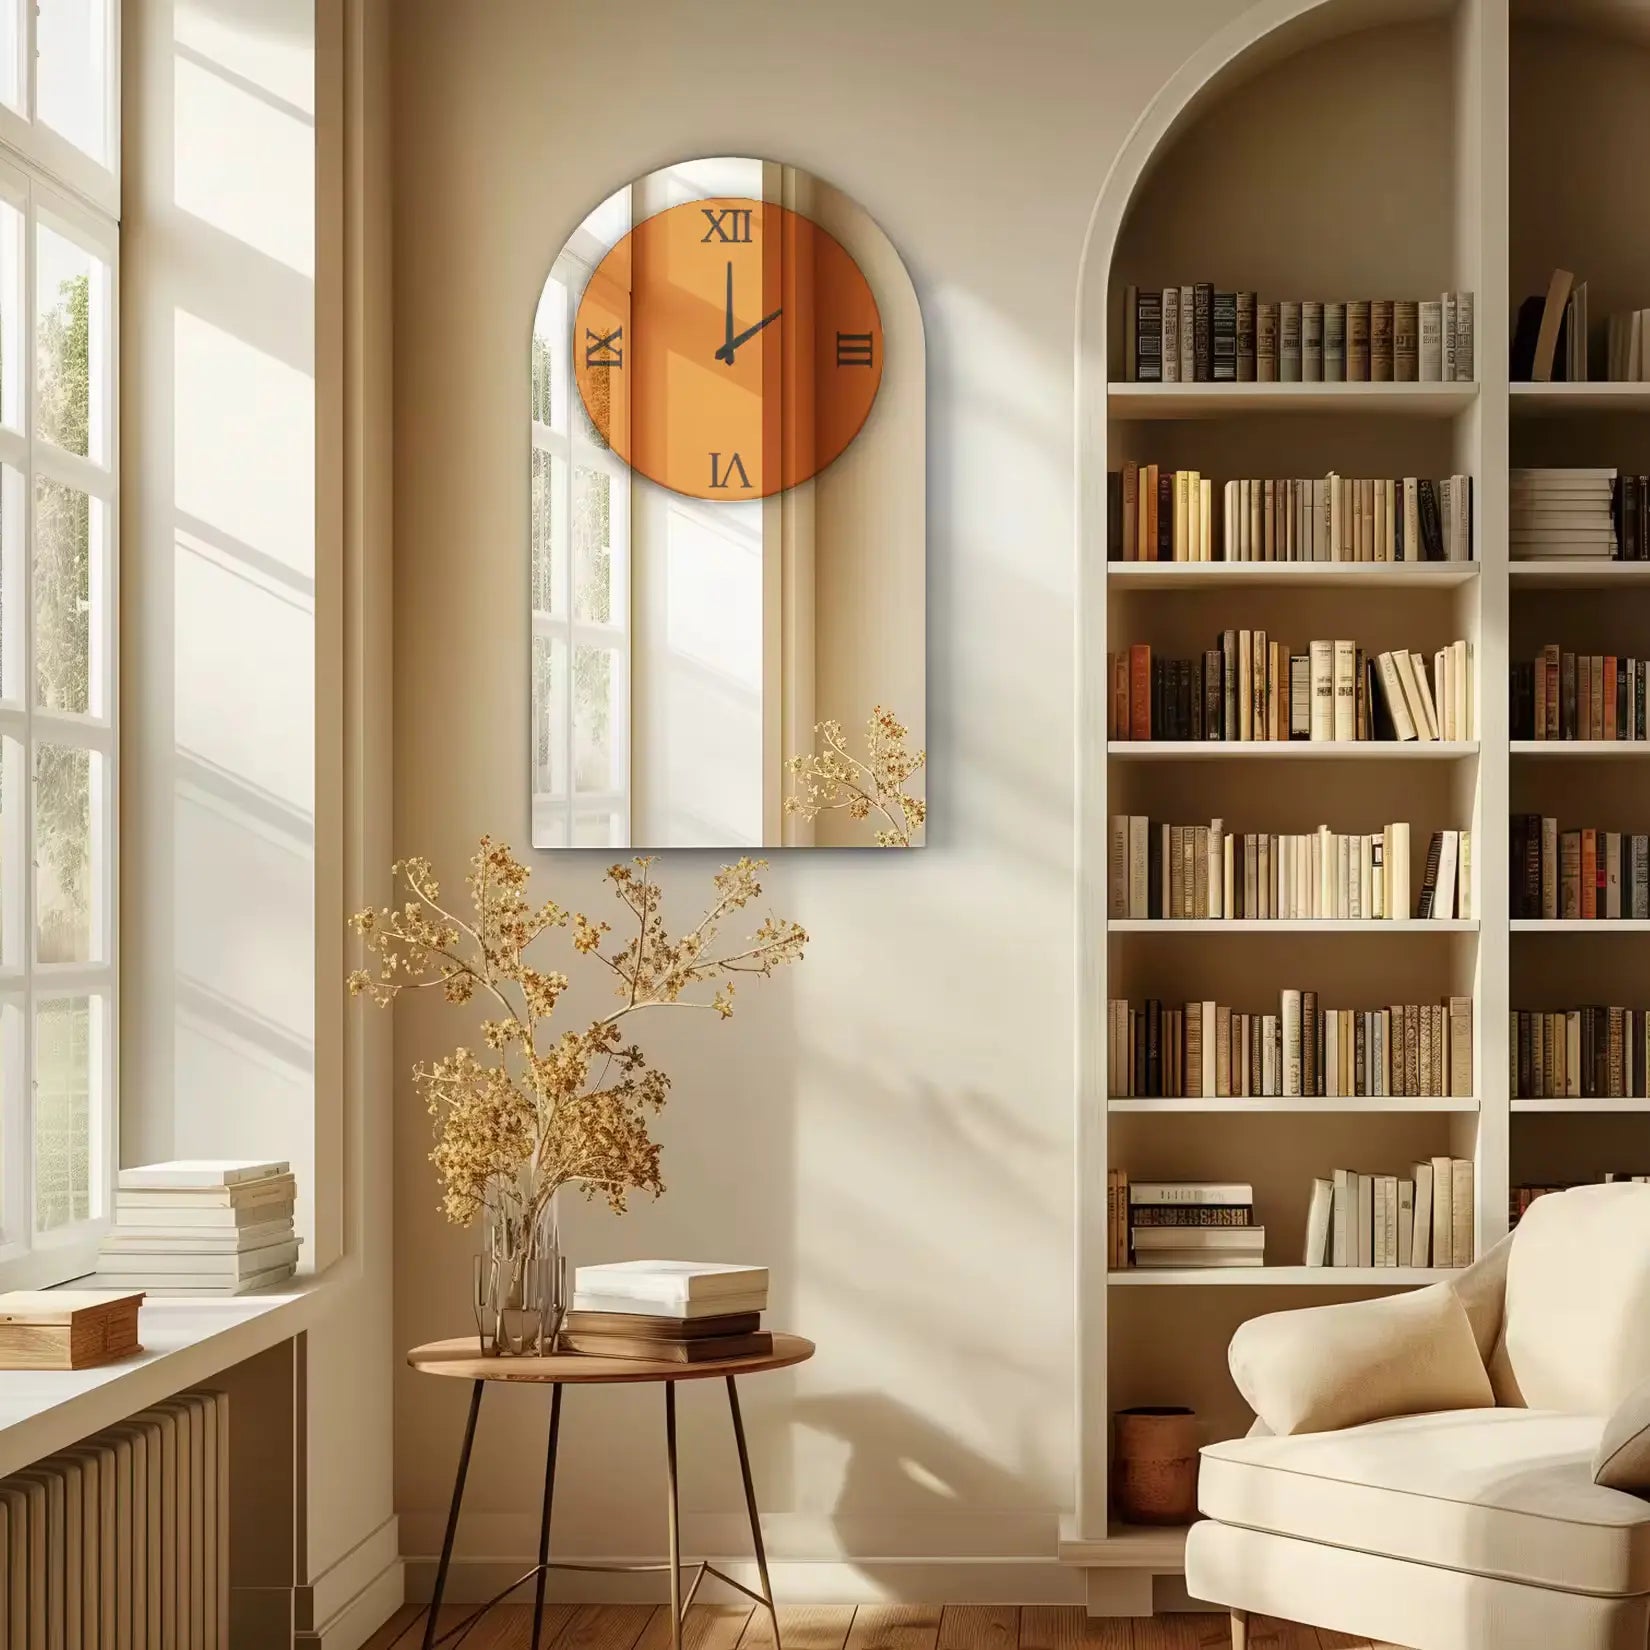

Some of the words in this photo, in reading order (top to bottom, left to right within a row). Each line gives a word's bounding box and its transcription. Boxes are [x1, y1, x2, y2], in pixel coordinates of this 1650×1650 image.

[701, 209, 752, 243] XII
[586, 326, 623, 370] IX
[836, 331, 873, 368] III
[708, 452, 753, 488] VI
